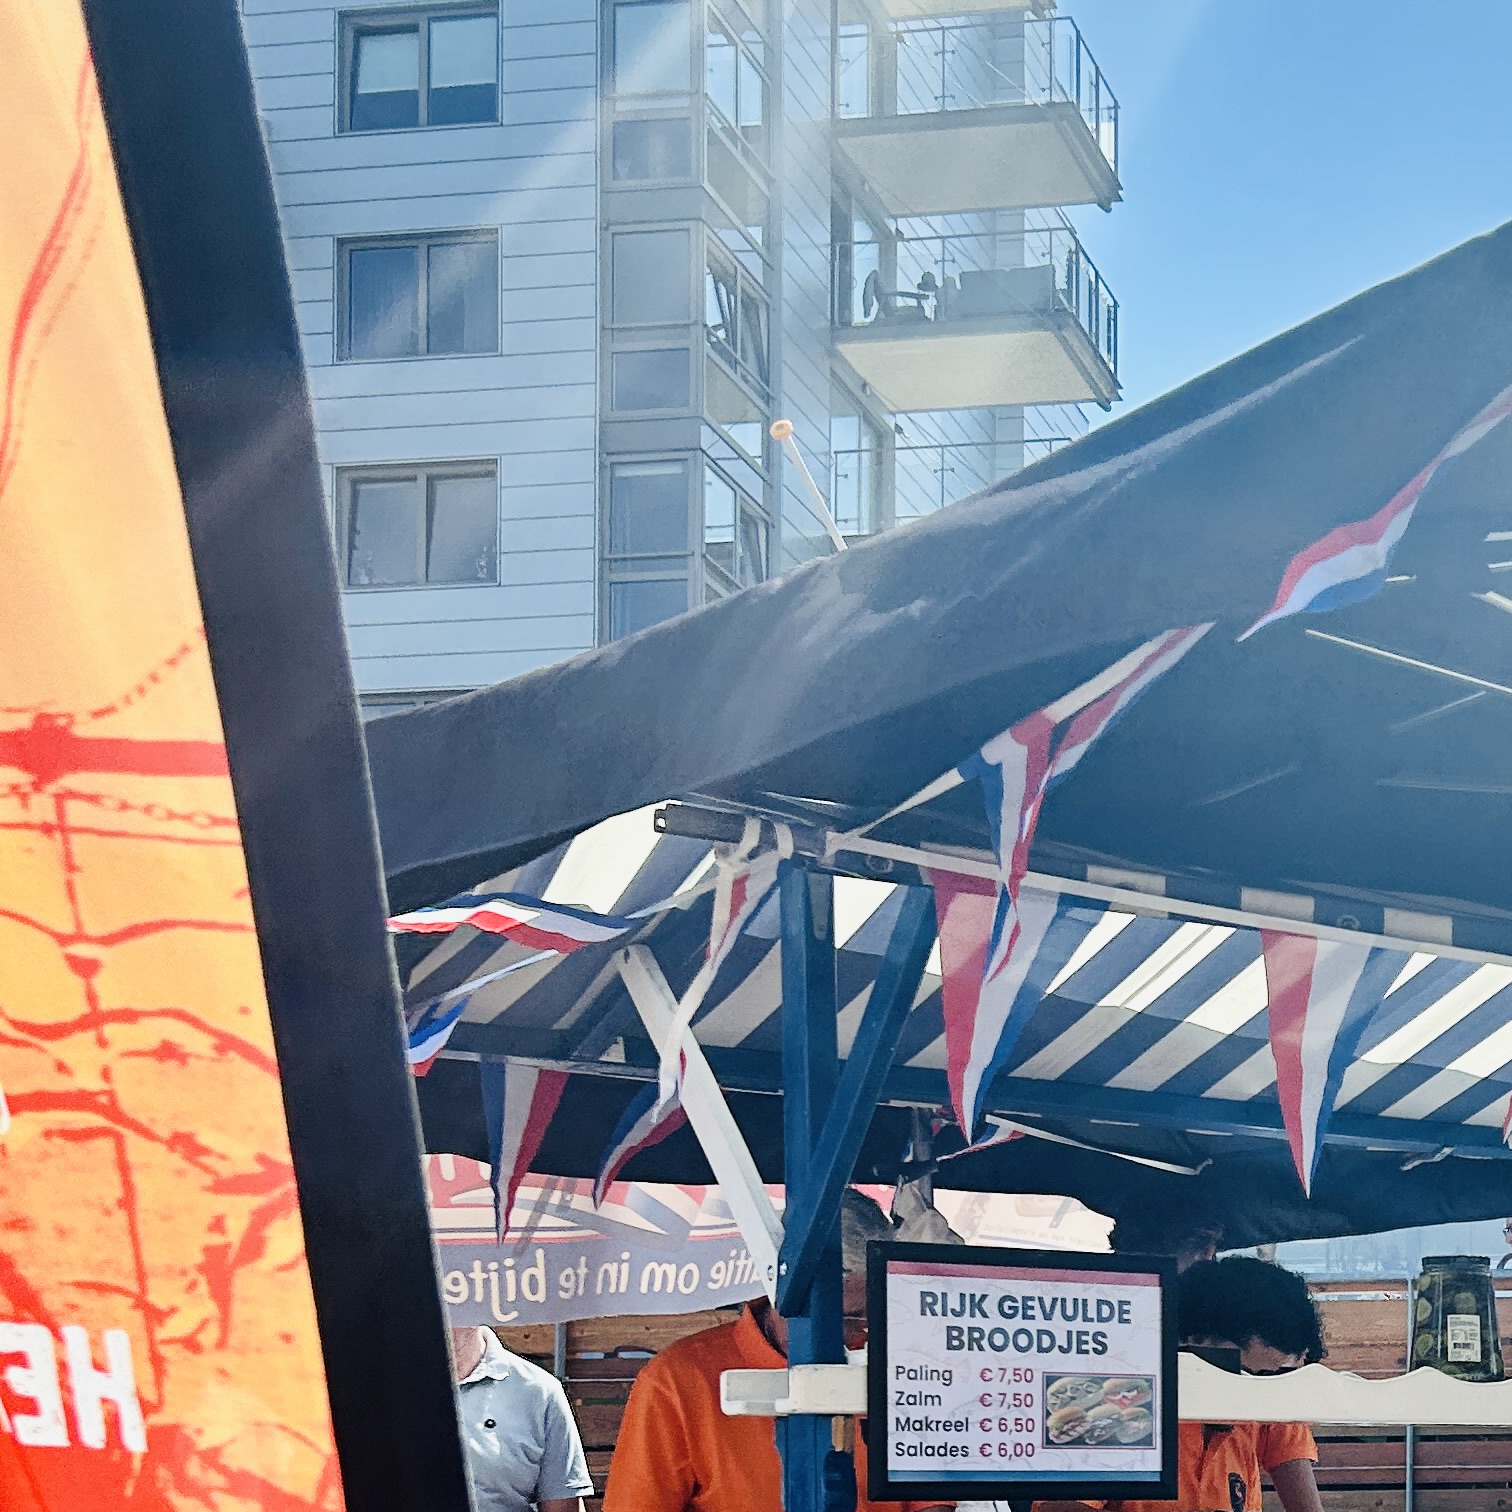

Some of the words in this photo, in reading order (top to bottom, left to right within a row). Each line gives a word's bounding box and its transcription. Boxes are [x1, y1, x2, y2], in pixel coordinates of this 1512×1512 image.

[920, 1290, 989, 1319] RIJK
[998, 1294, 1132, 1325] GEVULDE
[946, 1326, 1109, 1355] BROODJES
[895, 1366, 953, 1386] Paling
[895, 1391, 942, 1407] Zalm
[895, 1417, 970, 1434] Makreel
[895, 1441, 970, 1459] Salades
